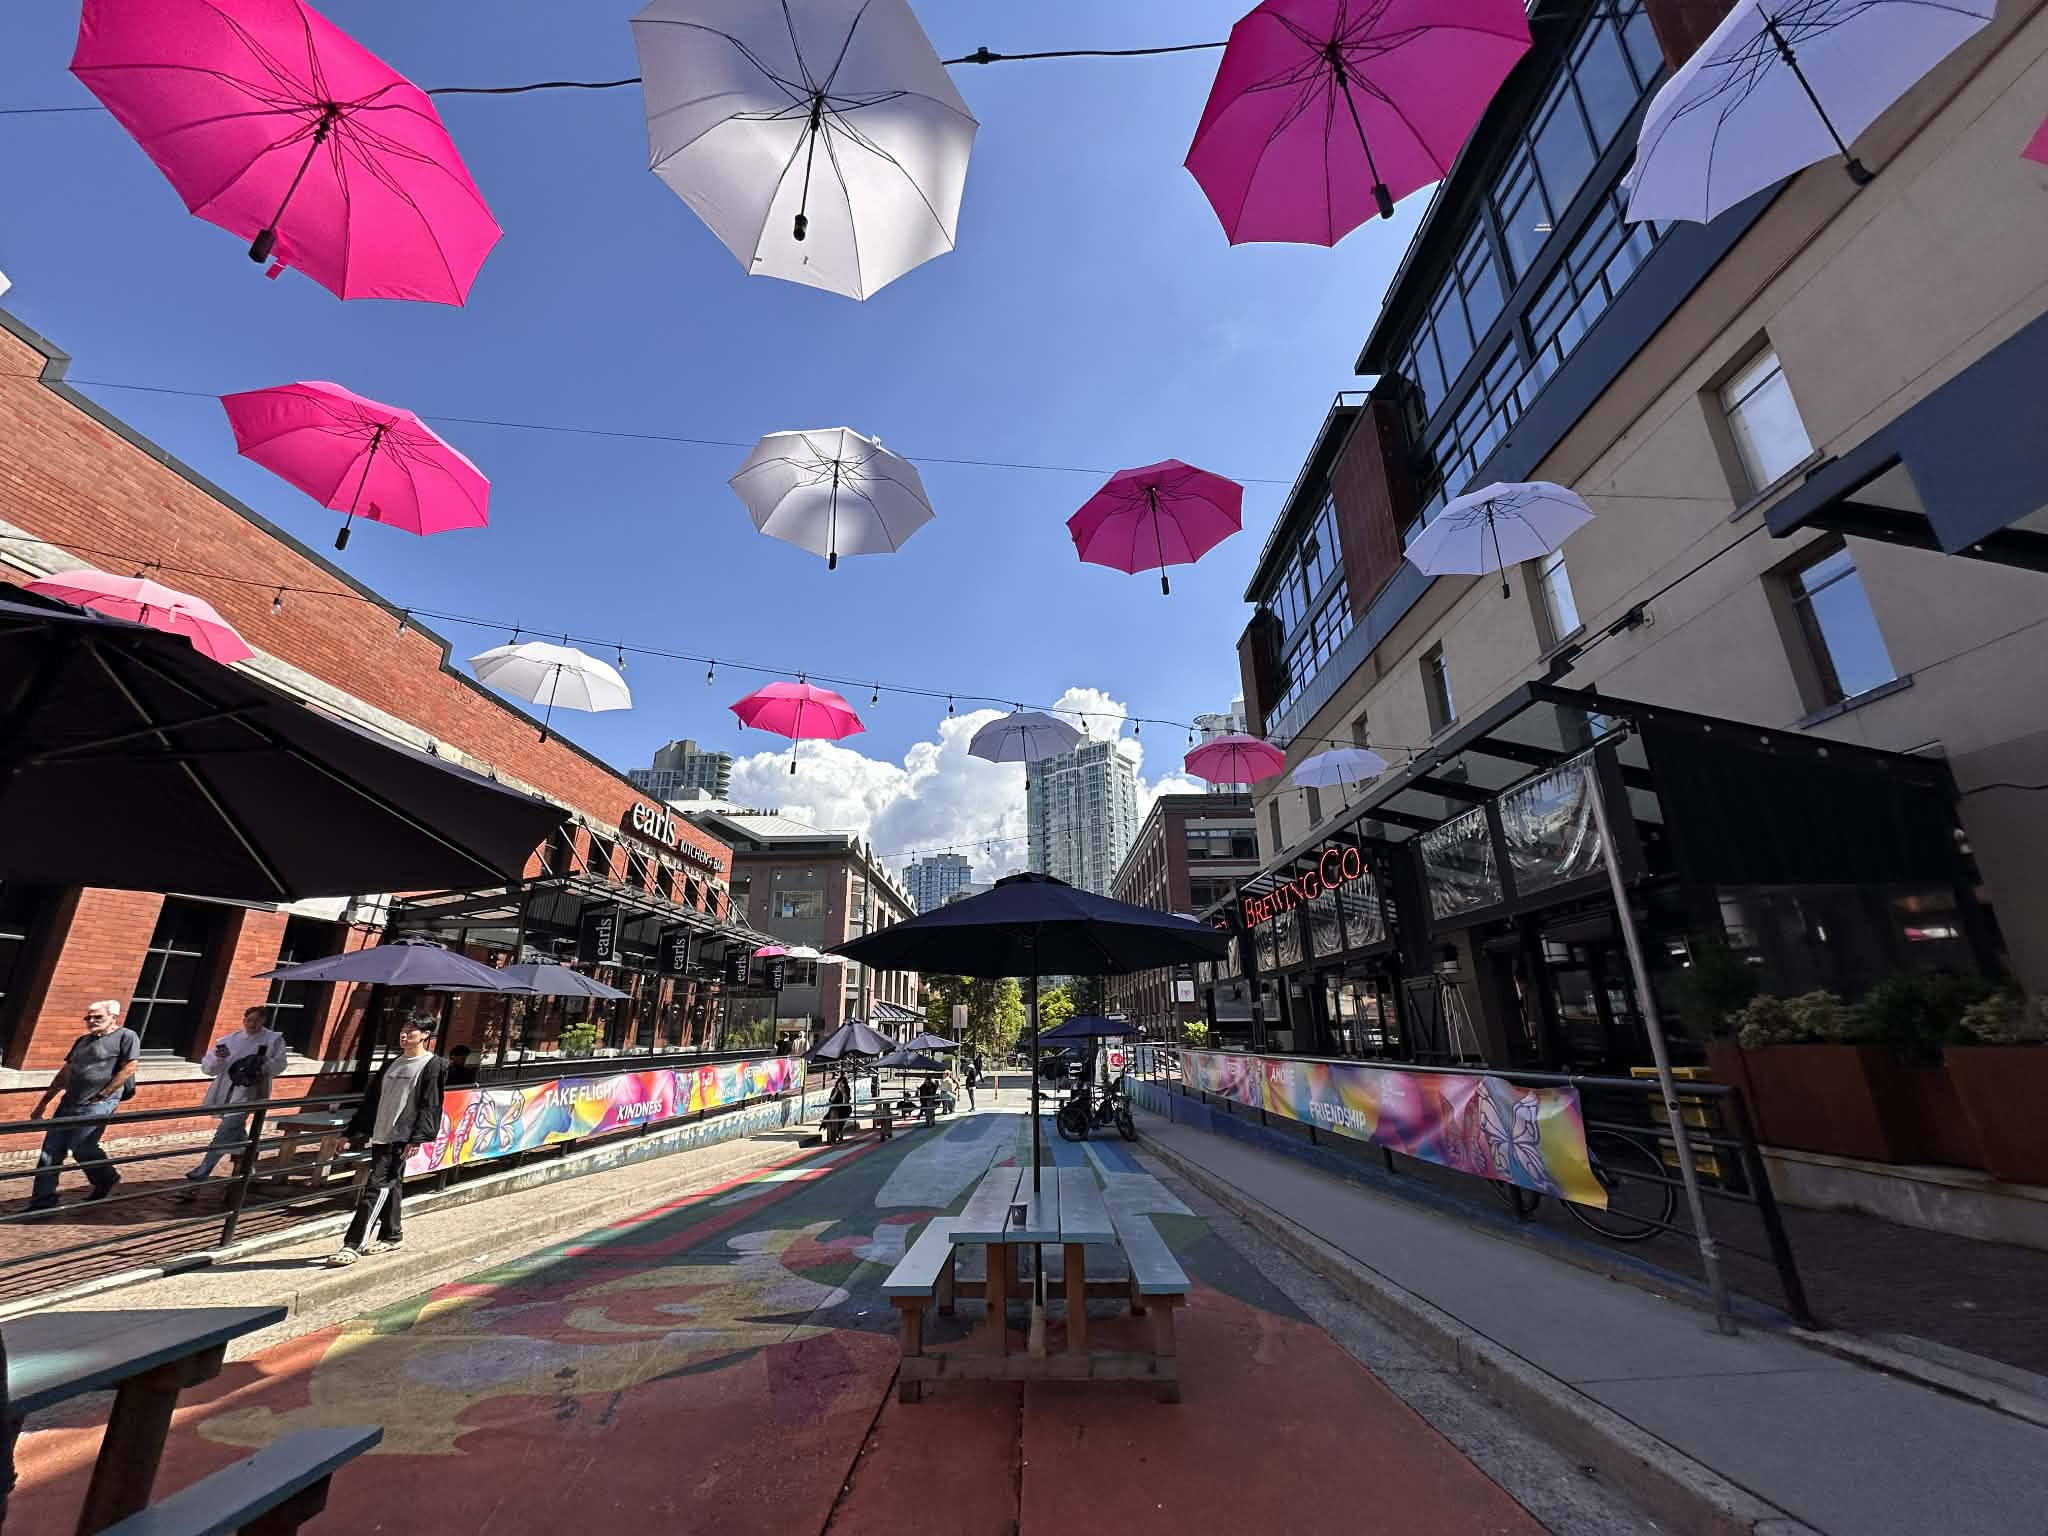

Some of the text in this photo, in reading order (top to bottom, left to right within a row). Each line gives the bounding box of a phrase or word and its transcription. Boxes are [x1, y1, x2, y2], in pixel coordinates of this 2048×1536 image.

[633, 802, 676, 847] earls
[680, 840, 709, 864] KITCHEN
[1244, 871, 1319, 929] BREWING
[595, 917, 613, 957] earls
[671, 937, 687, 970] earls
[737, 954, 747, 982] earls
[772, 964, 782, 990] earls
[544, 1082, 618, 1107] TAKE FLIGHT
[615, 1098, 663, 1121] KINDNESS
[1308, 1101, 1367, 1131] FRIENDSHIP
